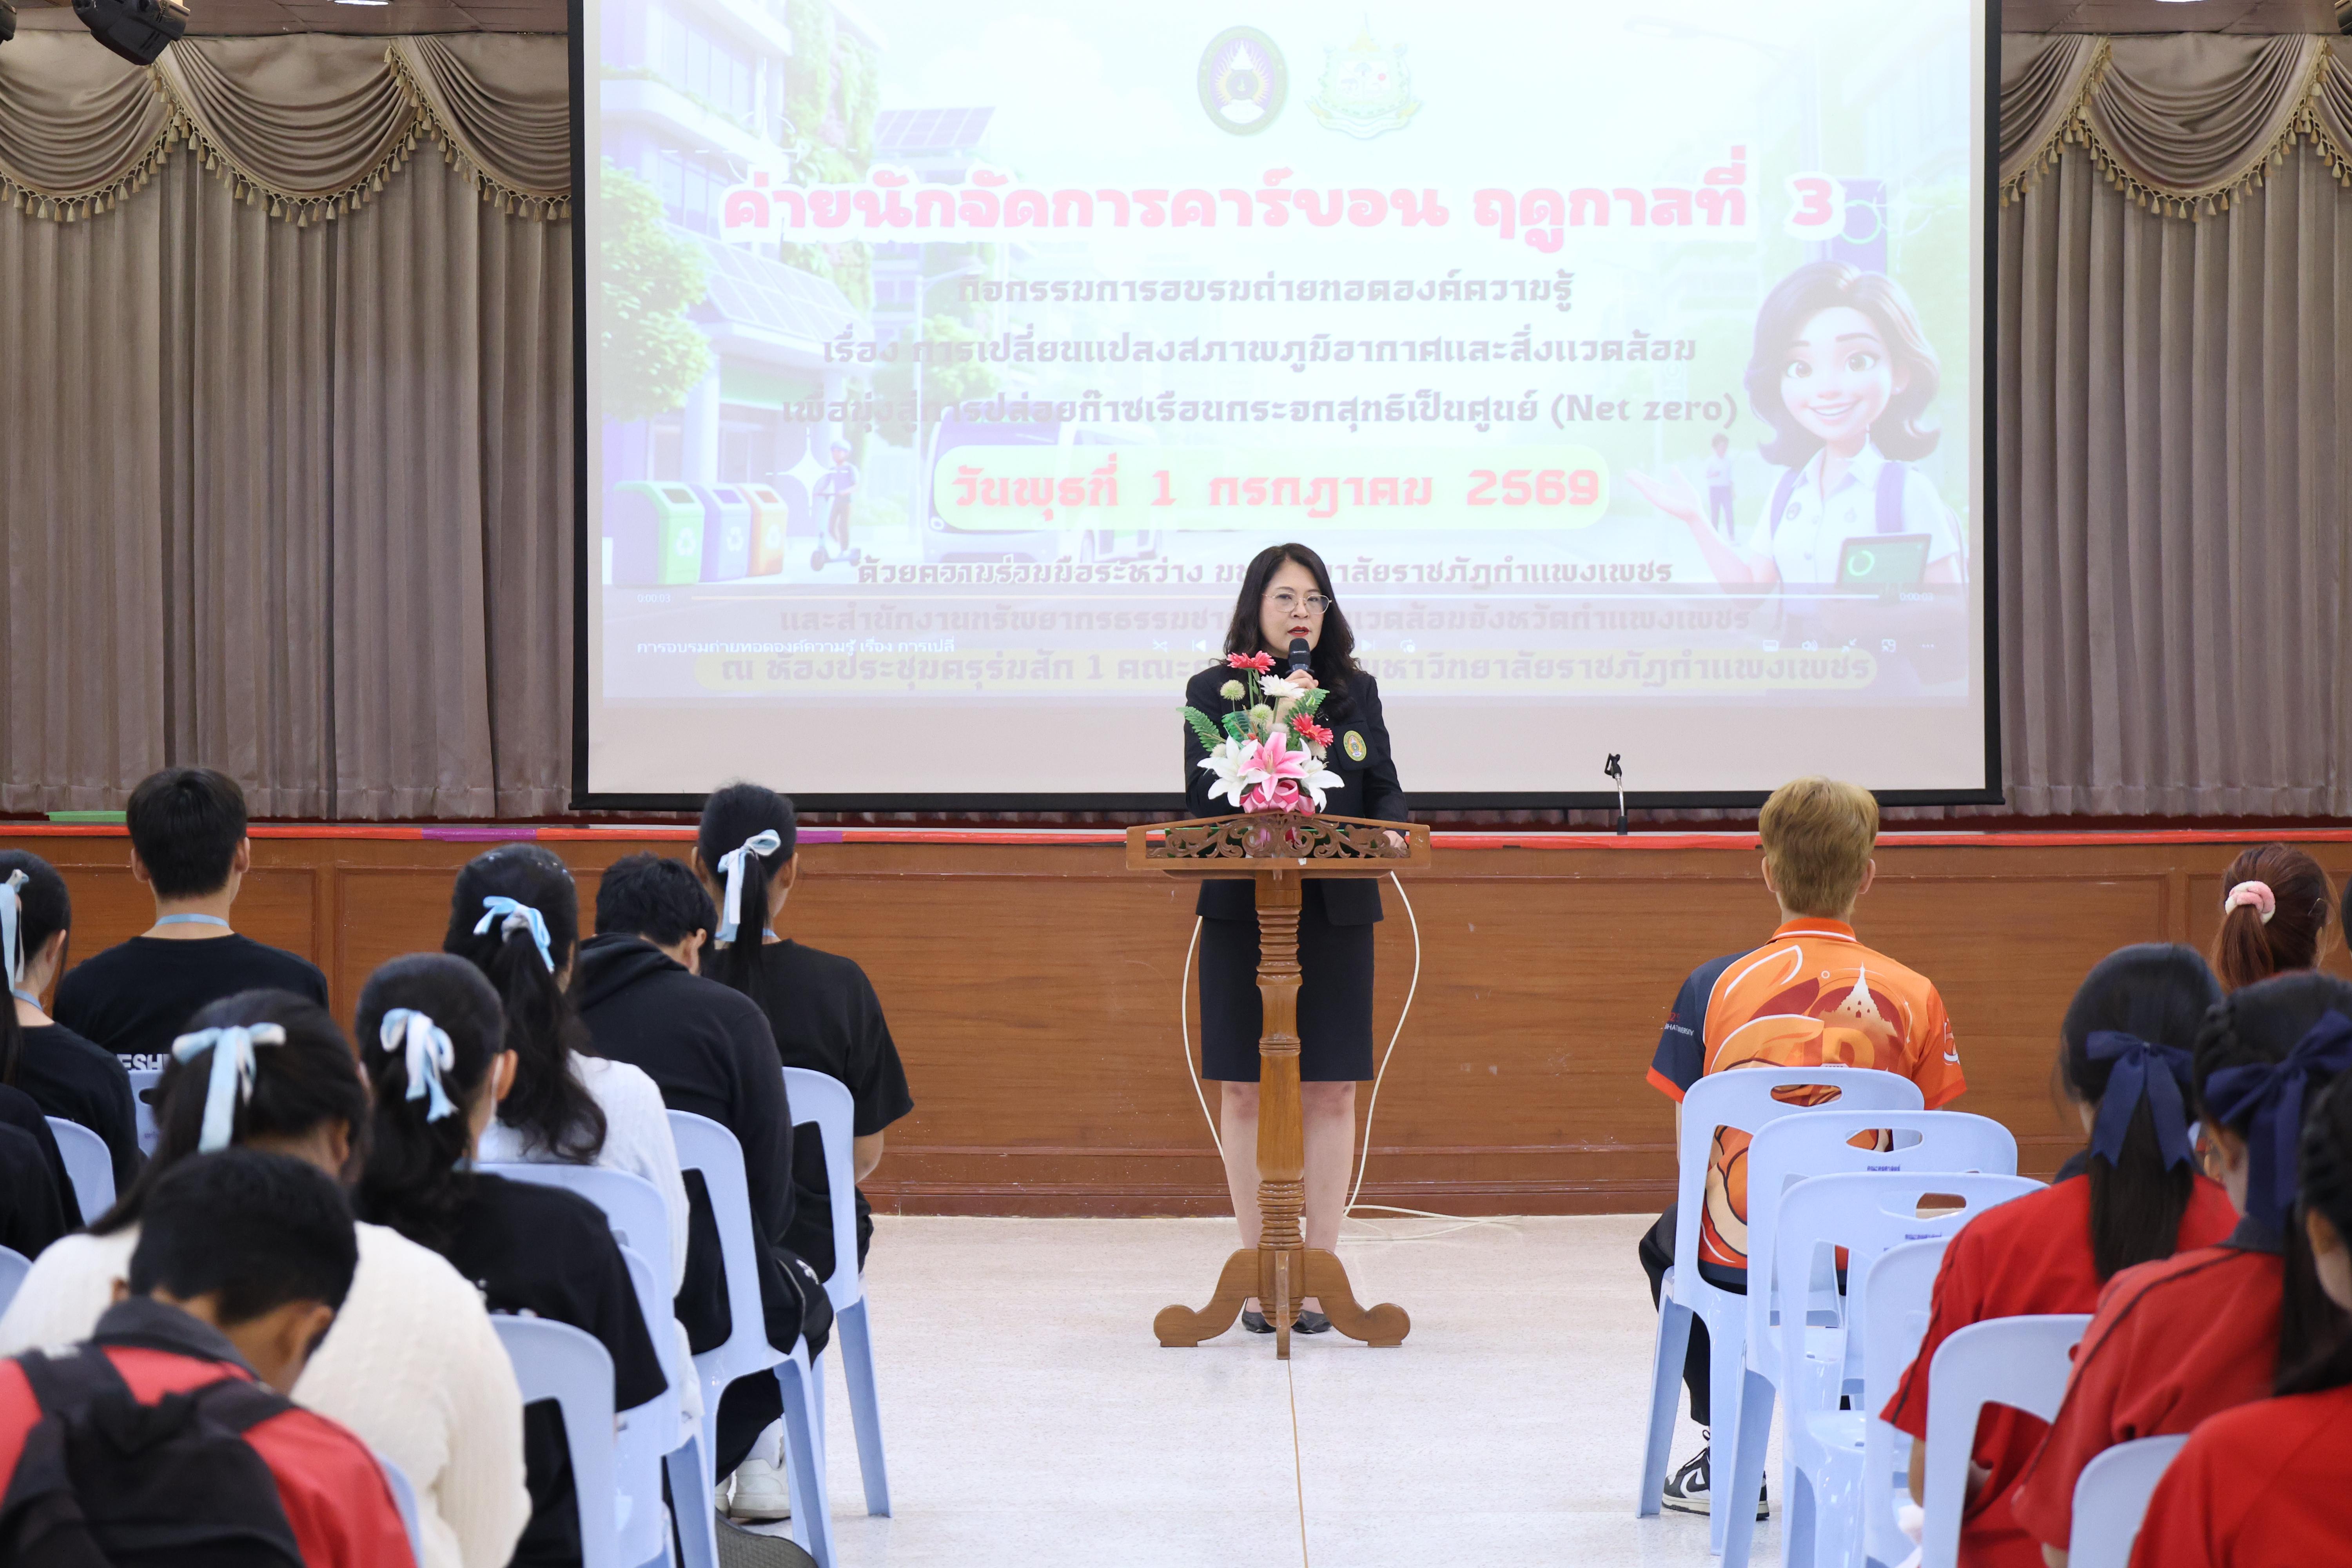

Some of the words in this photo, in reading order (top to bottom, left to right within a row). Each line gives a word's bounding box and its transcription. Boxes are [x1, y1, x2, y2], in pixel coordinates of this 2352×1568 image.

[724, 166, 1450, 228] ค่ายนักจัดการคาร์บอน
[1473, 144, 1747, 254] ฤดูกาลที่
[1791, 178, 1833, 227] 3
[958, 268, 1576, 313] กิจกรรมการอบรมถ่ายทอดองค์ความรู้
[823, 322, 898, 363] เรื่อง
[1550, 392, 1632, 429] (Net
[1642, 392, 1738, 429] zero)
[952, 452, 1120, 522] วันพุธที่
[1150, 470, 1178, 506] 1
[1208, 476, 1434, 519] กรกฎาคม
[1466, 469, 1600, 506] 2569
[637, 593, 671, 603] 0:00:03
[860, 635, 893, 652] เรื่อง
[721, 660, 753, 681] ณ
[1086, 654, 1104, 680] 1
